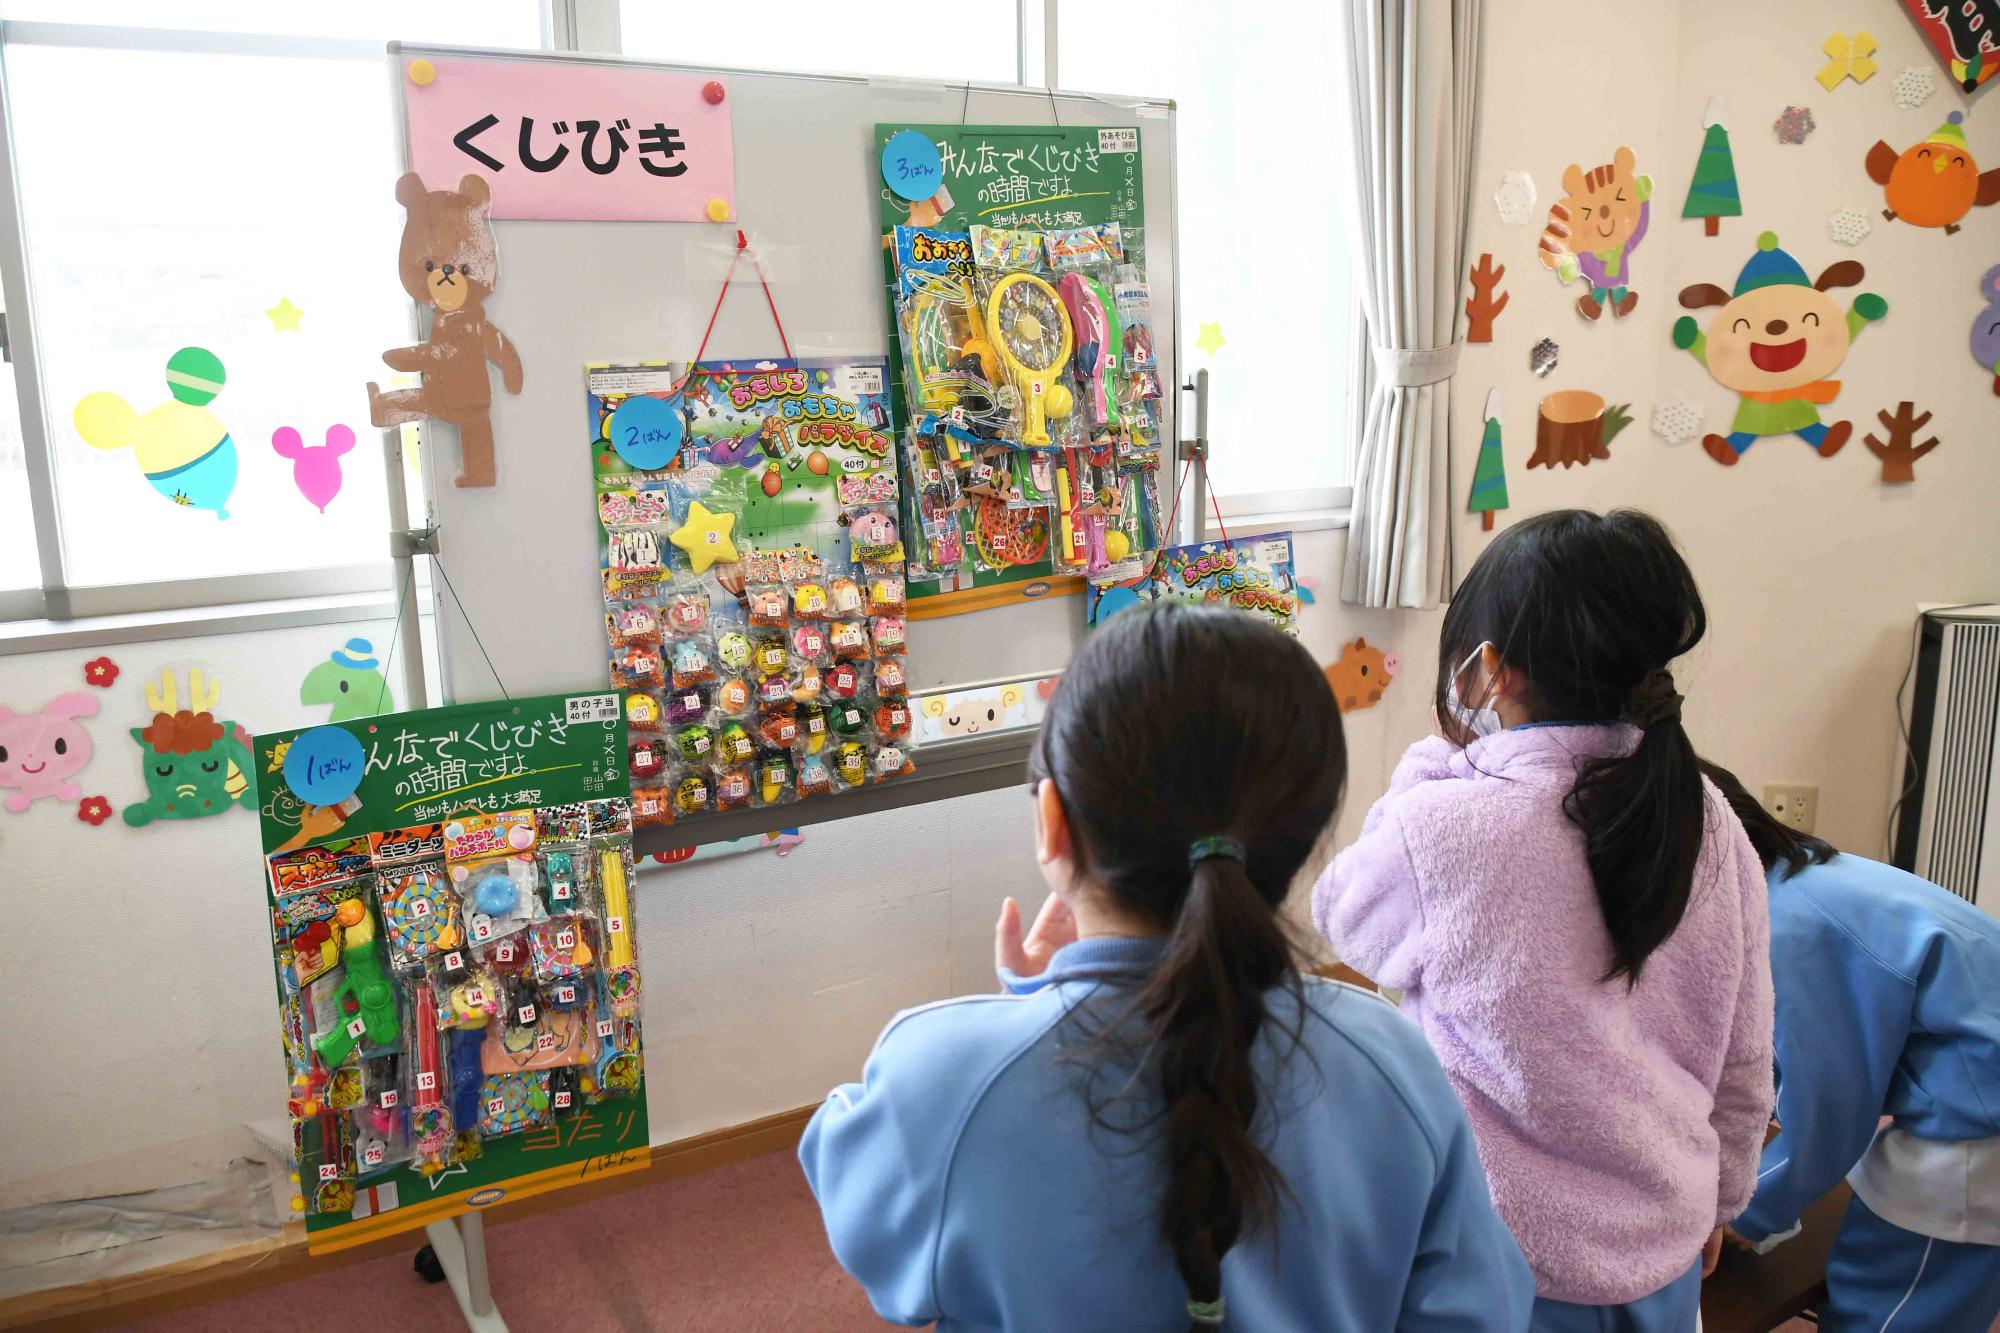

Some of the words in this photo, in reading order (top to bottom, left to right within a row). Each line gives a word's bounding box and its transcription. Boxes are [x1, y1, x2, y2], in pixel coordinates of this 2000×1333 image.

[1100, 131, 1135, 140] 外あそび当
[453, 113, 688, 177] くじびき
[936, 140, 1100, 178] みんなでくじびき
[897, 157, 934, 180] 3ばん
[1108, 358, 1114, 366] 4
[1137, 352, 1144, 361] 5
[730, 372, 805, 406] おもしろ
[1034, 383, 1041, 393] 3
[782, 396, 855, 419] おもちゃ
[954, 410, 961, 419] 2
[625, 426, 672, 447] 2ばん
[800, 422, 889, 453] パラダイス
[1121, 442, 1129, 450] 17
[844, 459, 866, 470] 40付
[1083, 492, 1094, 501] 22
[935, 512, 944, 520] 24
[994, 538, 1005, 547] 26
[1075, 535, 1084, 544] 21
[641, 550, 647, 560] 1
[1183, 551, 1235, 582] おもしろ
[1218, 569, 1268, 590] おもちゃ
[811, 597, 821, 607] 10
[1230, 590, 1293, 613] パラダイス
[687, 607, 693, 618] 7
[636, 618, 644, 628] 6
[844, 633, 855, 643] 18
[889, 629, 898, 640] 19
[734, 645, 745, 655] 15
[769, 652, 780, 662] 16
[637, 660, 649, 670] 13
[690, 658, 701, 668] 14
[839, 675, 851, 684] 25
[731, 691, 743, 701] 22
[771, 687, 783, 697] 23
[569, 697, 614, 710] 男の子当
[688, 697, 699, 708] 21
[569, 711, 591, 720] 40付
[636, 707, 648, 718] 20
[847, 711, 859, 721] 32
[893, 711, 904, 721] 33
[811, 720, 823, 731] 31
[782, 727, 794, 738] 30
[363, 712, 569, 777] んなでくじびき
[738, 741, 749, 752] 29
[638, 753, 650, 764] 27
[848, 757, 860, 767] 39
[306, 754, 352, 786] 1ばん
[772, 770, 784, 781] 37
[812, 769, 823, 779] 38
[695, 789, 706, 801] 35
[731, 784, 743, 795] 36
[413, 789, 543, 821] 当たりもハズレも大満足
[644, 802, 656, 812] 34
[455, 828, 495, 846] やわらか
[380, 838, 443, 860] ミニダーツ
[448, 838, 506, 859] パンチボール
[407, 862, 438, 875] DARTS
[558, 886, 567, 897] 4
[416, 903, 425, 914] 2
[611, 920, 620, 930] 5
[478, 925, 488, 937] 3
[560, 934, 573, 945] 10
[501, 949, 510, 959] 9
[449, 955, 459, 966] 8
[471, 991, 483, 1002] 14
[562, 989, 574, 1000] 16
[522, 1008, 535, 1020] 15
[353, 1023, 361, 1033] 1
[600, 1023, 611, 1034] 17
[539, 1036, 553, 1049] 22
[421, 1075, 434, 1087] 13
[384, 1094, 397, 1105] 19
[556, 1094, 570, 1105] 28
[490, 1101, 504, 1113] 27
[367, 1151, 382, 1161] 25
[321, 1166, 336, 1177] 24
